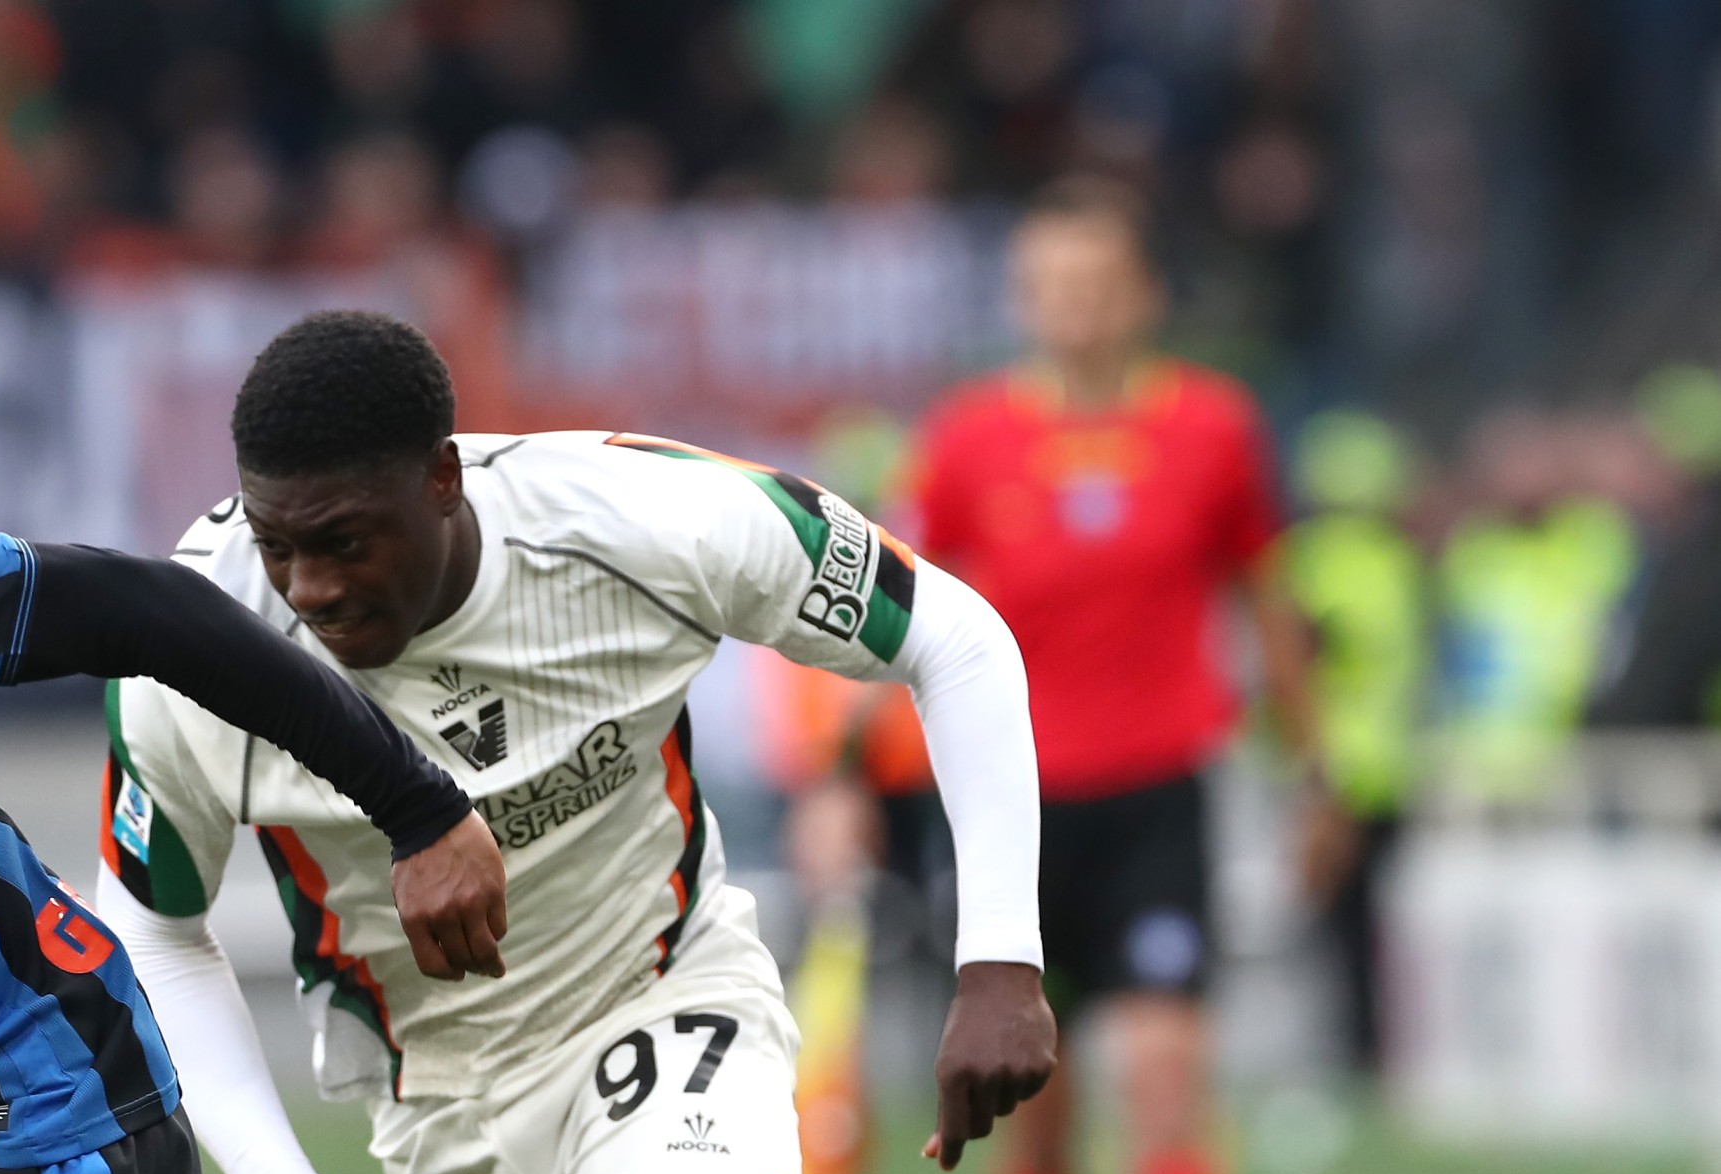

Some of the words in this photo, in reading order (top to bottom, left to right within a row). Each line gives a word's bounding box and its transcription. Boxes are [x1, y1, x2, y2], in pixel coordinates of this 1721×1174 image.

[431, 683, 492, 720] NOCTA
[474, 720, 628, 822] NAR
[505, 752, 638, 849] SPRITZ
[595, 1012, 739, 1122] 97
[666, 1140, 731, 1155] NOCTA
